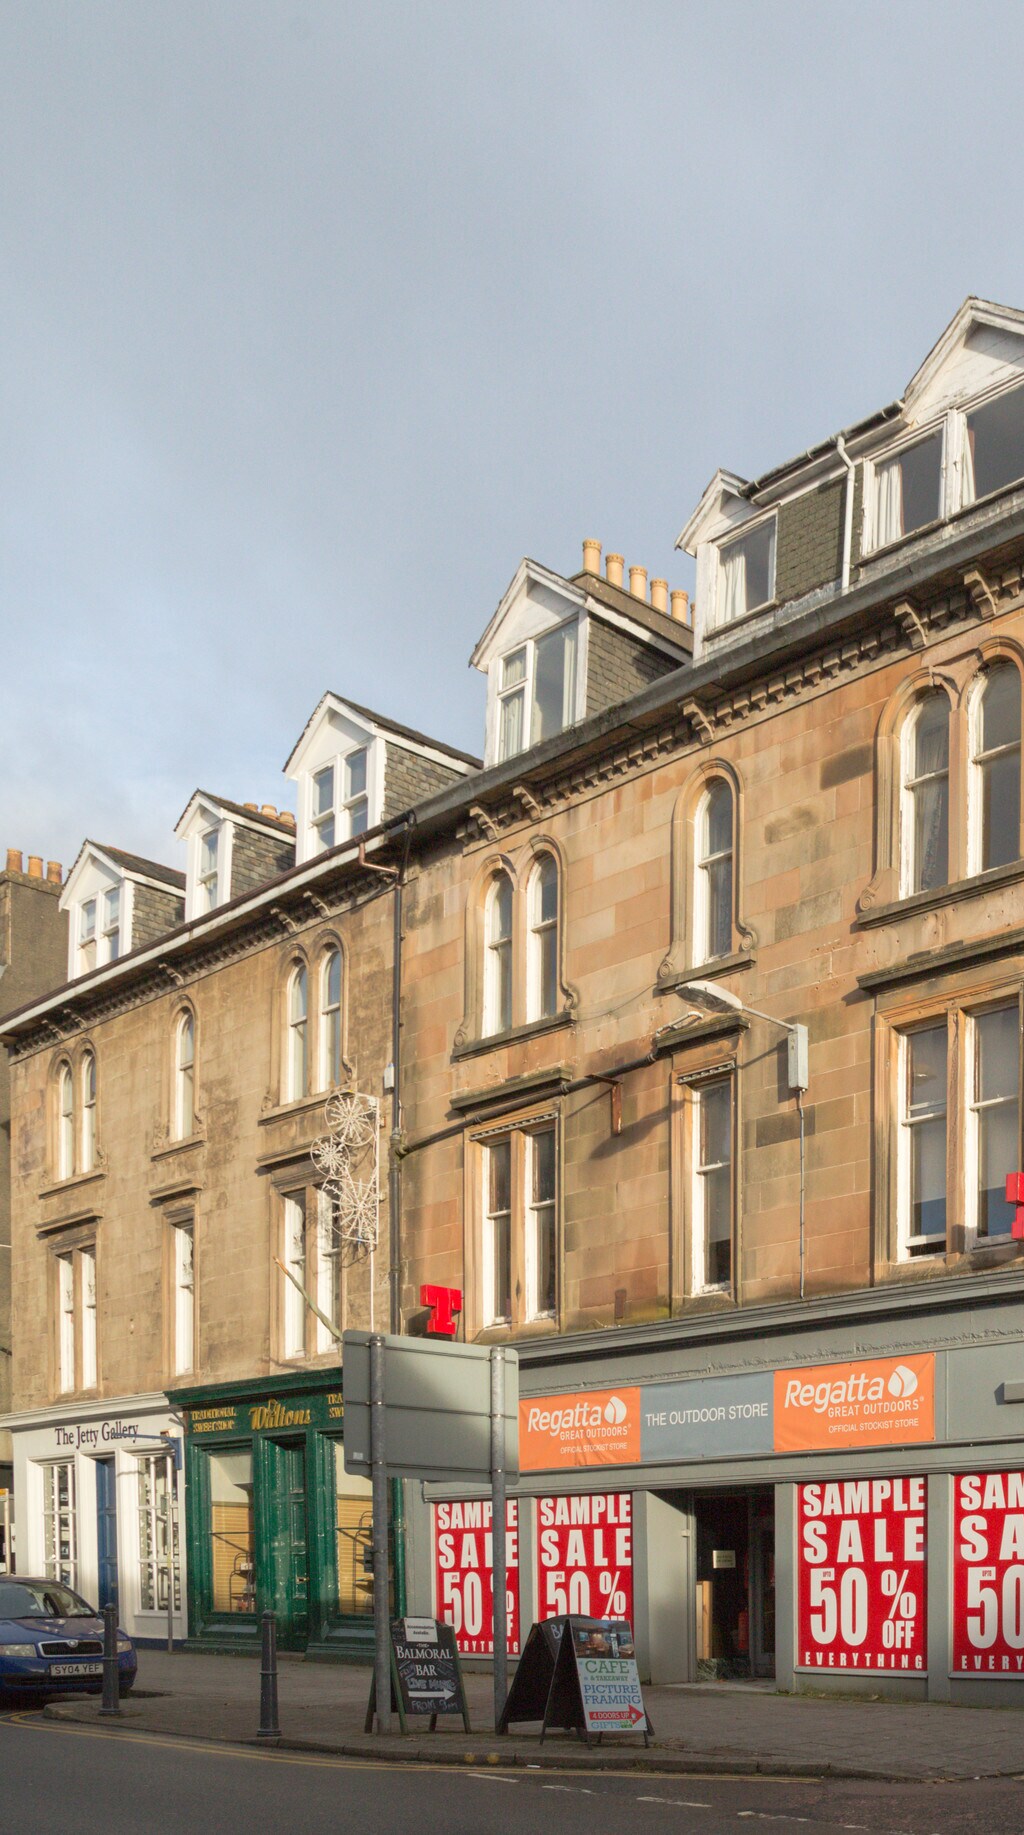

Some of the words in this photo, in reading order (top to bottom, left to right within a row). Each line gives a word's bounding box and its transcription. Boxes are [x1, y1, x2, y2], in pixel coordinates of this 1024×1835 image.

[420, 1284, 462, 1335] T
[784, 1373, 884, 1414] Regatta
[527, 1402, 602, 1437] Regatta
[645, 1412, 667, 1427] THE
[669, 1407, 726, 1425] OUTDOOR
[728, 1402, 769, 1419] STORE
[828, 1404, 860, 1419] GREAT
[863, 1399, 919, 1415] OUTDOORS
[55, 1427, 75, 1446] The
[76, 1425, 99, 1449] Jetty
[101, 1422, 139, 1444] Gallery
[560, 1429, 585, 1441] GREAT
[586, 1425, 628, 1438] OUTDOORS
[828, 1424, 858, 1434] OFFICIAL
[859, 1420, 893, 1432] STOCKIST
[894, 1417, 919, 1428] STORE
[560, 1444, 582, 1454] OFFICIAL
[583, 1443, 608, 1453] STOCKIST
[609, 1442, 627, 1451] STORE
[803, 1477, 925, 1517] SAMPLE
[437, 1499, 518, 1530] SAMPE
[540, 1493, 631, 1526] SAMPLE
[541, 1528, 632, 1567] SALE
[803, 1516, 925, 1564] SALE
[882, 1619, 915, 1649] OFF
[396, 1645, 454, 1659] BALMORAL
[805, 1651, 924, 1669] EVERYTHING
[415, 1664, 438, 1676] BAR
[585, 1660, 630, 1674] CAFE
[584, 1684, 639, 1694] PICTURE
[584, 1695, 641, 1704] FRAMING
[591, 1721, 620, 1729] GIFTS
